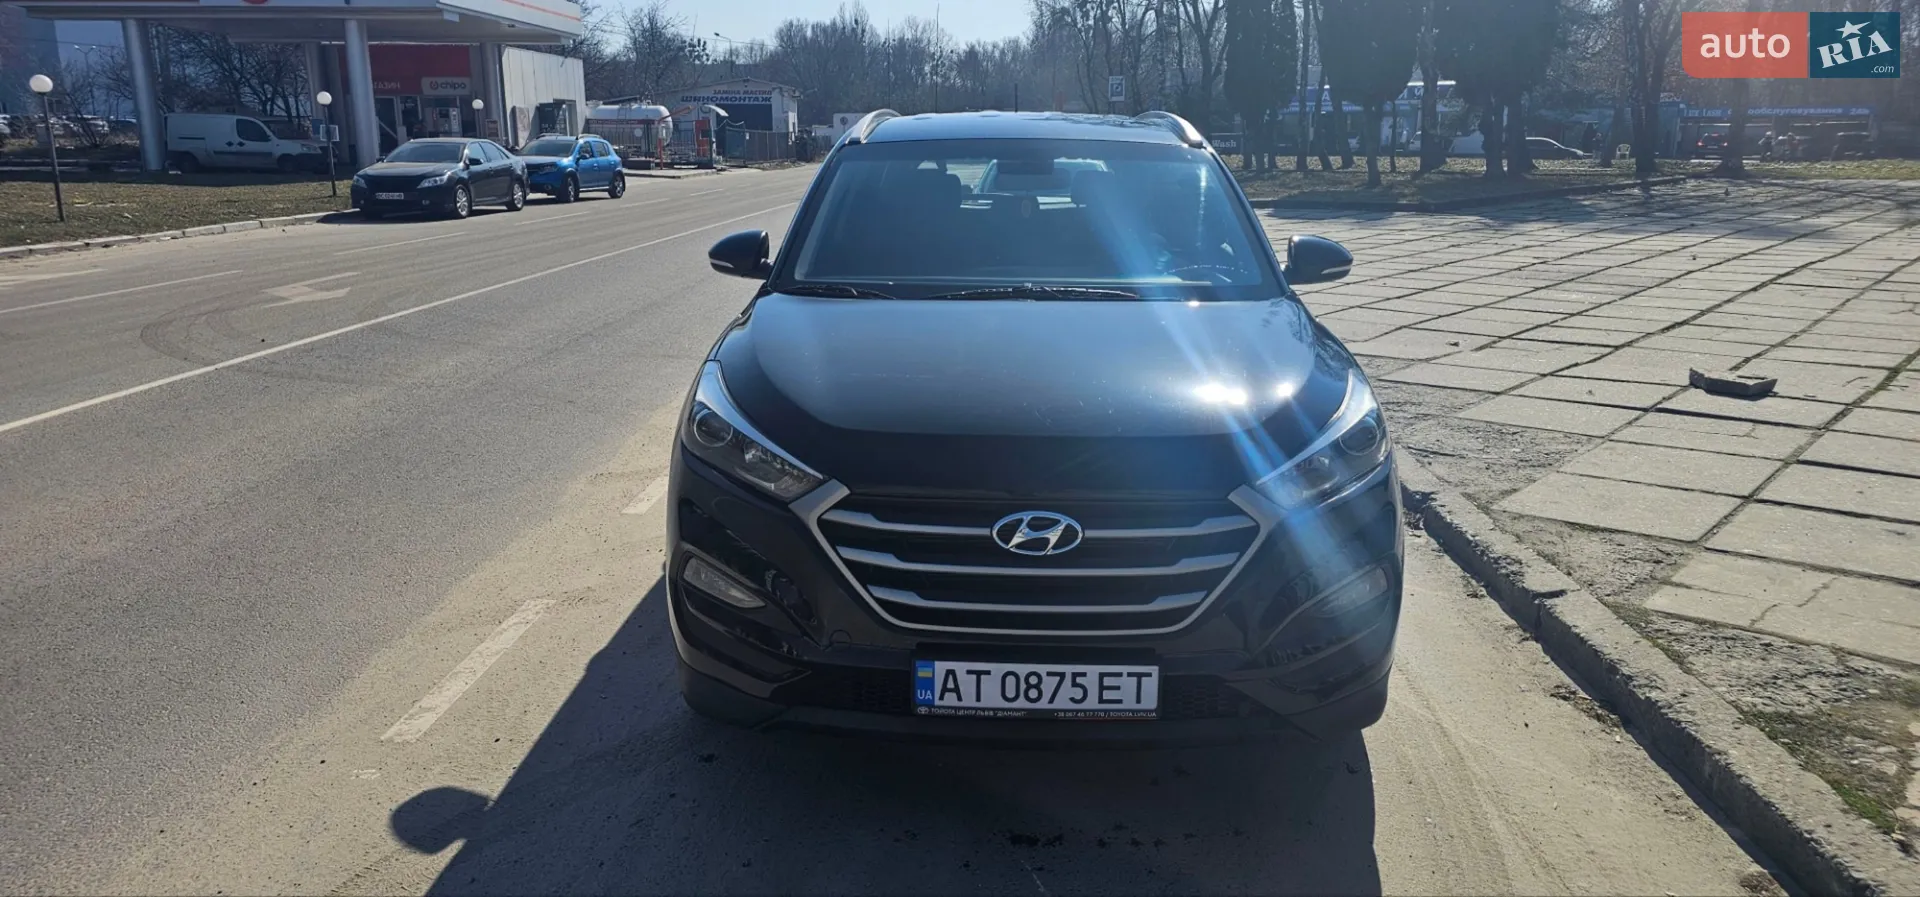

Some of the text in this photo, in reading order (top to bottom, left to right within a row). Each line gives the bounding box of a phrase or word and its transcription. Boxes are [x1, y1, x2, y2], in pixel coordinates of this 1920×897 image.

[440, 81, 466, 90] chipo
[681, 95, 773, 103] ШИНОМОНТАЖ
[938, 669, 1152, 705] AT 0875 ET
[917, 690, 933, 700] UA
